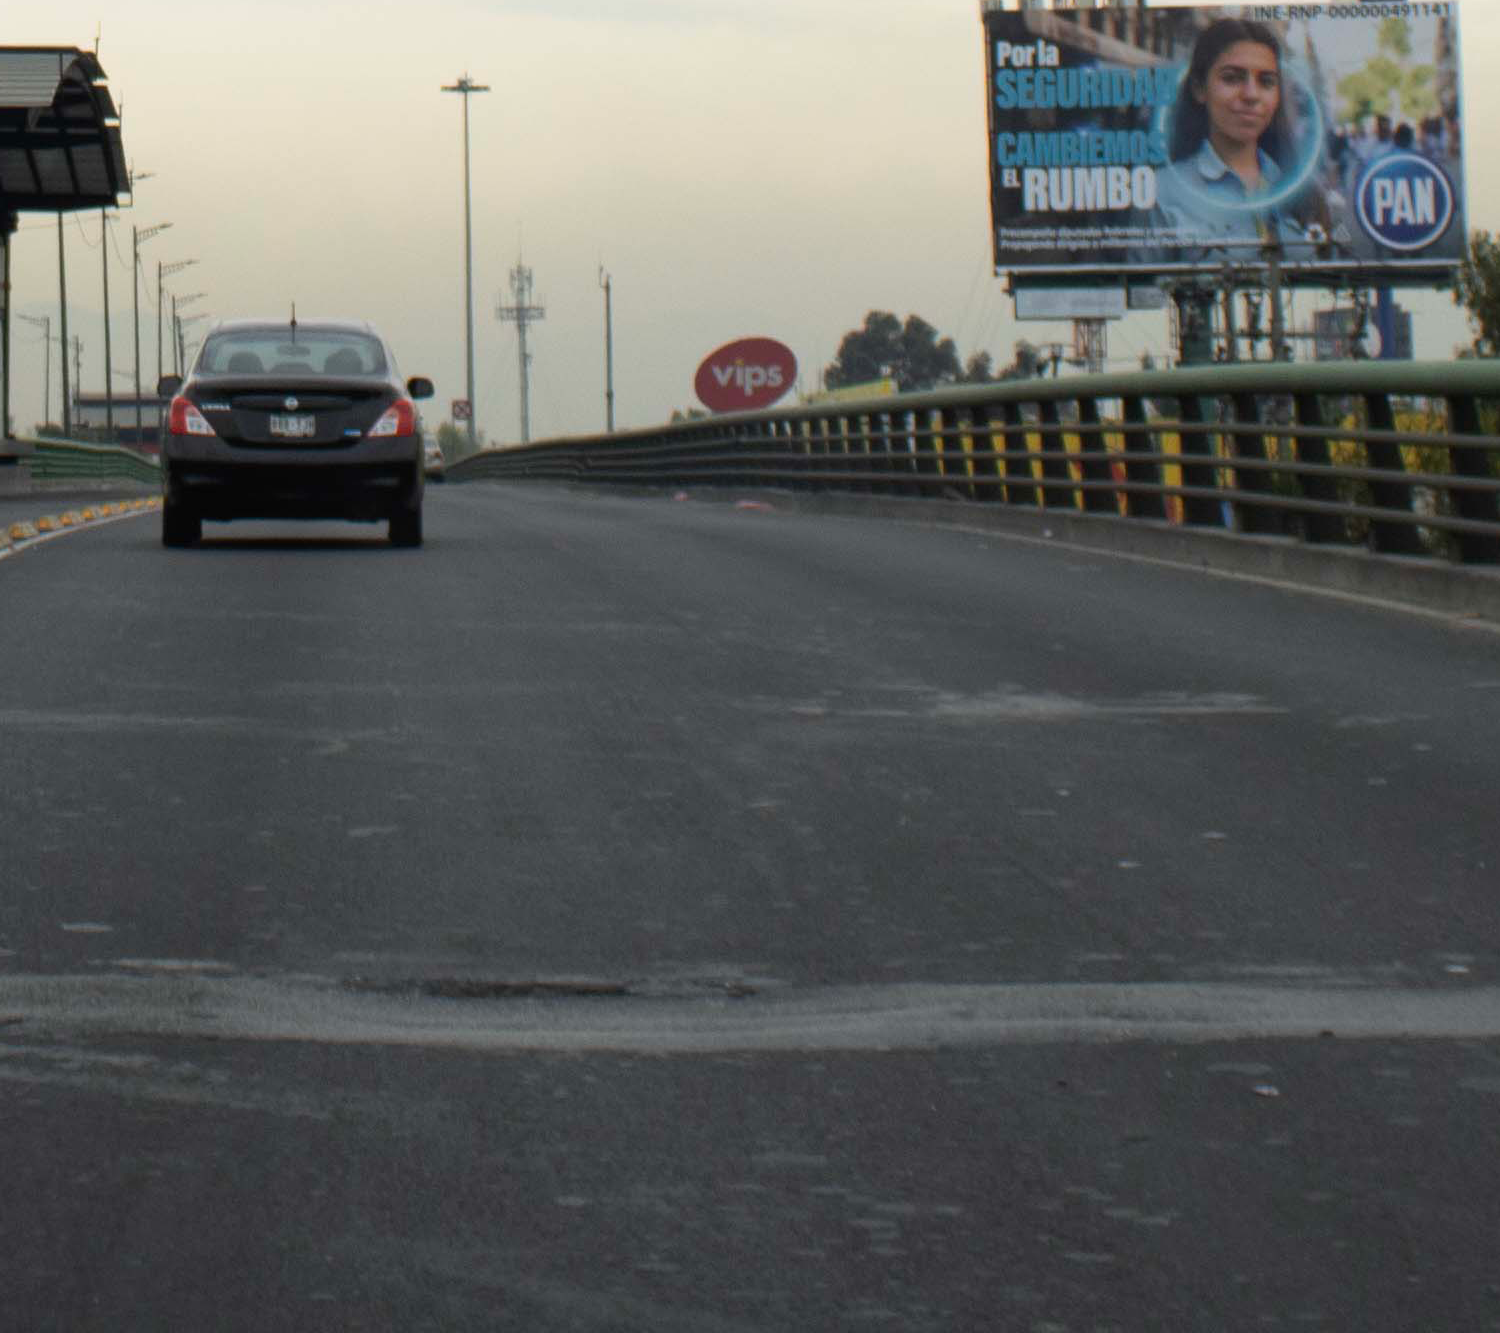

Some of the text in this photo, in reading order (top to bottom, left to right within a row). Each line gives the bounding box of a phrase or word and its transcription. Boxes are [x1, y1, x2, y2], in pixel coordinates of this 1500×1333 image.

[997, 38, 1060, 67] Por la
[998, 130, 1166, 166] CAMBIEMOS
[1024, 165, 1156, 212] RUMBO
[1374, 177, 1436, 226] PAN
[712, 359, 783, 397] vips
